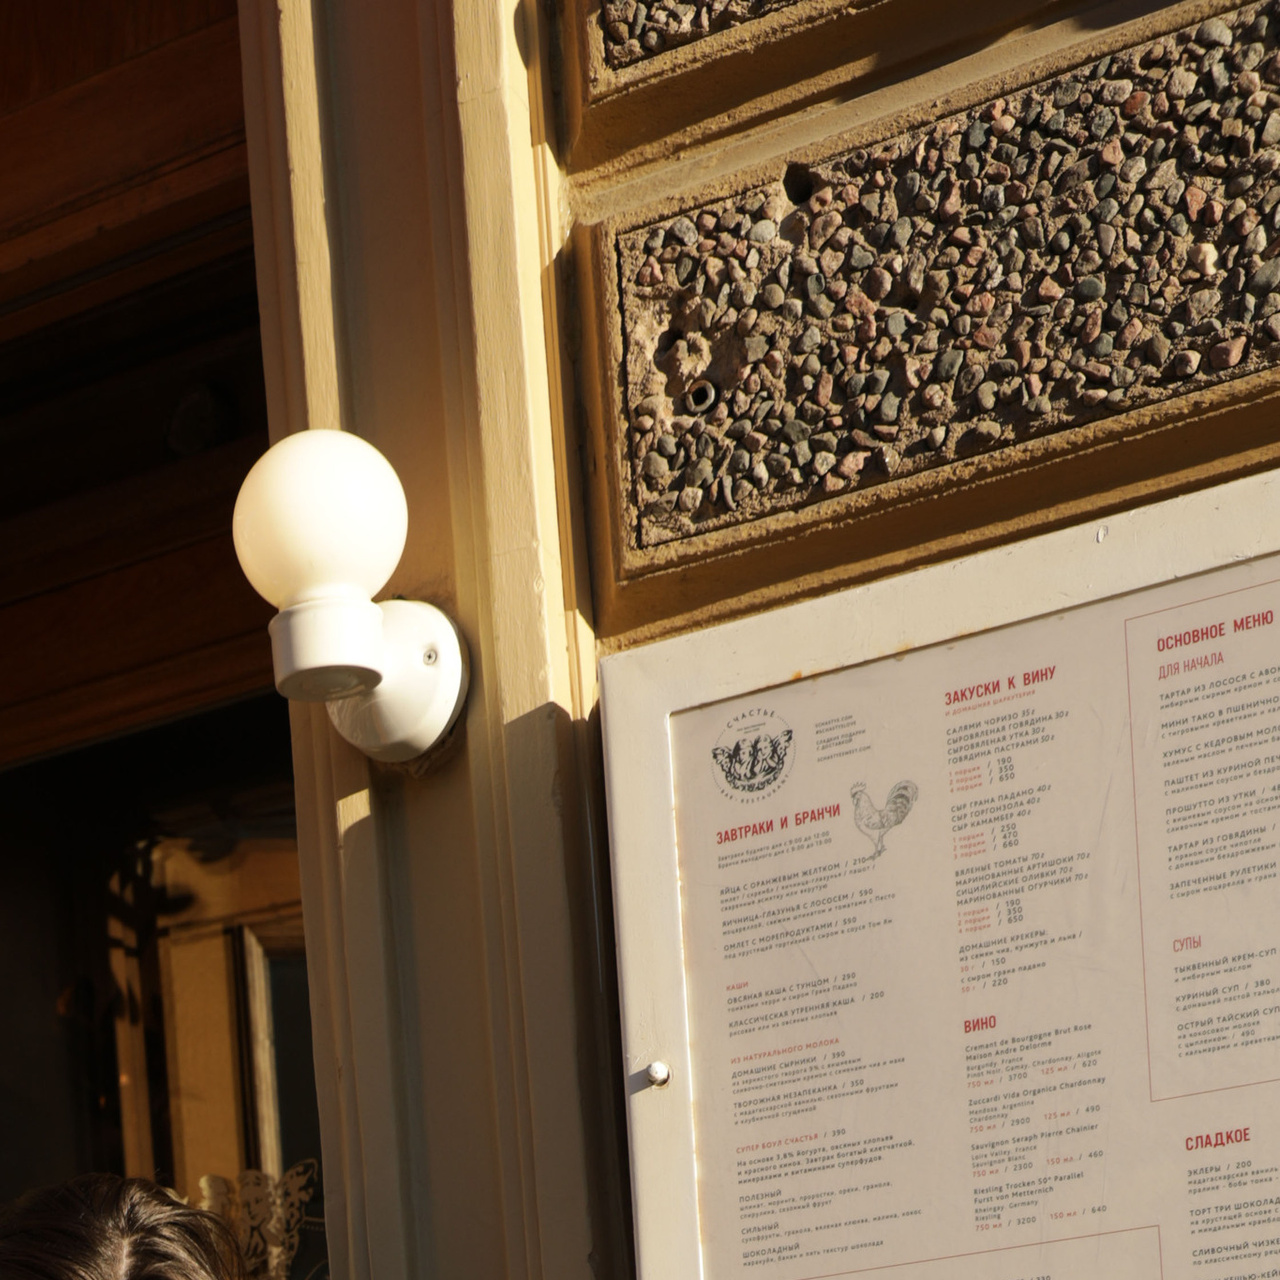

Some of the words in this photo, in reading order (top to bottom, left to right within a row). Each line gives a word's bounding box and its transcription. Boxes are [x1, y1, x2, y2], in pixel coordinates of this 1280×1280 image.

[1157, 622, 1225, 652] ОСНОВНОЕ
[1233, 610, 1274, 633] МЕНЮ
[1158, 662, 1180, 681] ДЛЯ
[1183, 651, 1224, 673] НАЧАЛА
[945, 679, 1000, 706] ЗАКУСКИ
[1023, 665, 1056, 686] ВИНУ
[727, 708, 775, 728] СЧАСТЬЕ
[946, 721, 981, 736] САЛЯМИ
[984, 712, 1019, 726] ЧОРИЗО
[947, 725, 1006, 746] СЫРОВЯЛЕНАЯ
[1008, 714, 1053, 730] ГОВЯДИНА
[1161, 718, 1189, 730] МИНИ
[1191, 711, 1215, 722] ТАКО
[948, 749, 992, 765] ГОВЯДИНА
[994, 737, 1039, 754] ПАСТРАМИ
[997, 756, 1012, 765] 190
[999, 763, 1014, 774] 350
[999, 772, 1015, 782] 650
[951, 803, 967, 813] СЫР
[969, 797, 996, 808] ГРАНА
[998, 788, 1034, 802] ПАДАНО
[951, 813, 968, 823] СЫР
[970, 800, 1024, 818] ГОРГОНЗОЛА
[1166, 799, 1215, 816] ПРОШУТТО
[1218, 795, 1230, 804] ИЗ
[1232, 789, 1256, 801] УТКИ
[716, 819, 774, 845] ЗАВТРАКИ
[780, 816, 788, 829] И
[795, 803, 840, 826] БРАНЧИ
[1000, 822, 1017, 833] 250
[1002, 830, 1018, 840] 470
[1002, 838, 1019, 849] 660
[1168, 840, 1199, 853] ТАРТАР
[1202, 837, 1214, 846] ИЗ
[1216, 826, 1266, 842] ГОВЯДИНЫ
[720, 886, 741, 896] ЯЙЦА
[750, 872, 799, 889] ОРАНЖЕВЫМ
[802, 862, 840, 877] ЖЕЛТКОМ
[853, 857, 866, 866] 210
[955, 863, 991, 877] ВЯЛЕНЫЕ
[994, 855, 1028, 868] ТОМАТЫ
[955, 866, 1024, 887] МАРИНОВАННЫЕ
[1026, 855, 1074, 872] АРТИШОКИ
[1170, 872, 1227, 890] ЗАПЕЧЕННЫЕ
[1230, 862, 1277, 877] РУЛЕТИКИ
[956, 877, 1019, 897] СИЦИЛИЙСКИЕ
[1021, 869, 1057, 883] ОЛИВКИ
[722, 904, 800, 927] ЯИЧНИЦА-ГЛАЗУНЬЯ
[810, 893, 849, 908] ЛОСОСЕМ
[1173, 935, 1202, 953] СУПЫ
[1174, 956, 1229, 973] ТЫКВЕННЫЙ
[1231, 948, 1277, 963] КРЕМ-СУП
[726, 981, 749, 991] КАШИ
[727, 991, 763, 1005] ОВСЯНАЯ
[764, 987, 787, 997] КАША
[796, 977, 829, 990] ТУНЦОМ
[842, 972, 856, 981] 290
[1175, 987, 1219, 1003] КУРИНЫЙ
[1221, 984, 1239, 994] СУП
[1255, 978, 1271, 988] 380
[729, 1010, 789, 1028] КЛАССИЧЕСКАЯ
[791, 1001, 830, 1016] УТРЕННЯЯ
[832, 997, 855, 1007] КАША
[870, 991, 884, 1000] 200
[964, 1015, 996, 1034] ВИНО
[731, 1056, 741, 1064] ИЗ
[743, 1044, 803, 1062] НАТУРАЛЬНОГО
[805, 1037, 840, 1049] МОЛОКА
[965, 1041, 997, 1053] Cremant
[1011, 1031, 1052, 1044] Bourgogne
[1054, 1027, 1071, 1036] Brut
[1073, 1024, 1092, 1032] Rose
[965, 1052, 992, 1061] Maison
[994, 1047, 1017, 1056] Andre
[1019, 1041, 1052, 1052] Delorme
[731, 1064, 776, 1080] ДОМАШНИЕ
[779, 1056, 817, 1069] СЫРНИКИ
[832, 1050, 846, 1059] 390
[967, 1080, 981, 1088] 750
[1008, 1072, 1028, 1082] 3700
[1041, 1066, 1055, 1075] 125
[1082, 1059, 1098, 1068] 620
[733, 1094, 781, 1109] ТВОРОЖНАЯ
[783, 1084, 838, 1100] НЕЗАПЕКАНКА
[850, 1079, 864, 1088] 350
[968, 1095, 1001, 1107] Zuccardi
[1003, 1091, 1020, 1100] Vida
[1022, 1085, 1057, 1097] Organica
[1059, 1077, 1106, 1090] Chardonnay
[736, 1144, 759, 1154] СУПЕР
[761, 1139, 782, 1150] БОУЛ
[784, 1133, 818, 1145] СЧАСТЬЯ
[832, 1128, 846, 1137] 390
[971, 1139, 1009, 1151] Sauvignon
[1012, 1133, 1038, 1144] Seraph
[1040, 1130, 1063, 1139] Pierre
[1065, 1124, 1098, 1135] Chainier
[1185, 1127, 1250, 1151] СЛАДКОЕ
[1187, 1165, 1221, 1177] ЭКЛЕРЫ
[1236, 1160, 1252, 1169] 200
[974, 1186, 1003, 1195] Riesling
[1005, 1180, 1036, 1190] Trocken
[1054, 1171, 1084, 1182] Parallel
[974, 1196, 993, 1204] Furst
[1011, 1186, 1054, 1198] Metternich
[739, 1189, 782, 1203] ПОЛЕЗНЫЙ
[1189, 1207, 1212, 1217] ТОРТ
[1214, 1204, 1231, 1213] ТРИ
[741, 1222, 779, 1235] СИЛЬНЫЙ
[742, 1242, 800, 1259] ШОКОЛАДНЫЙ
